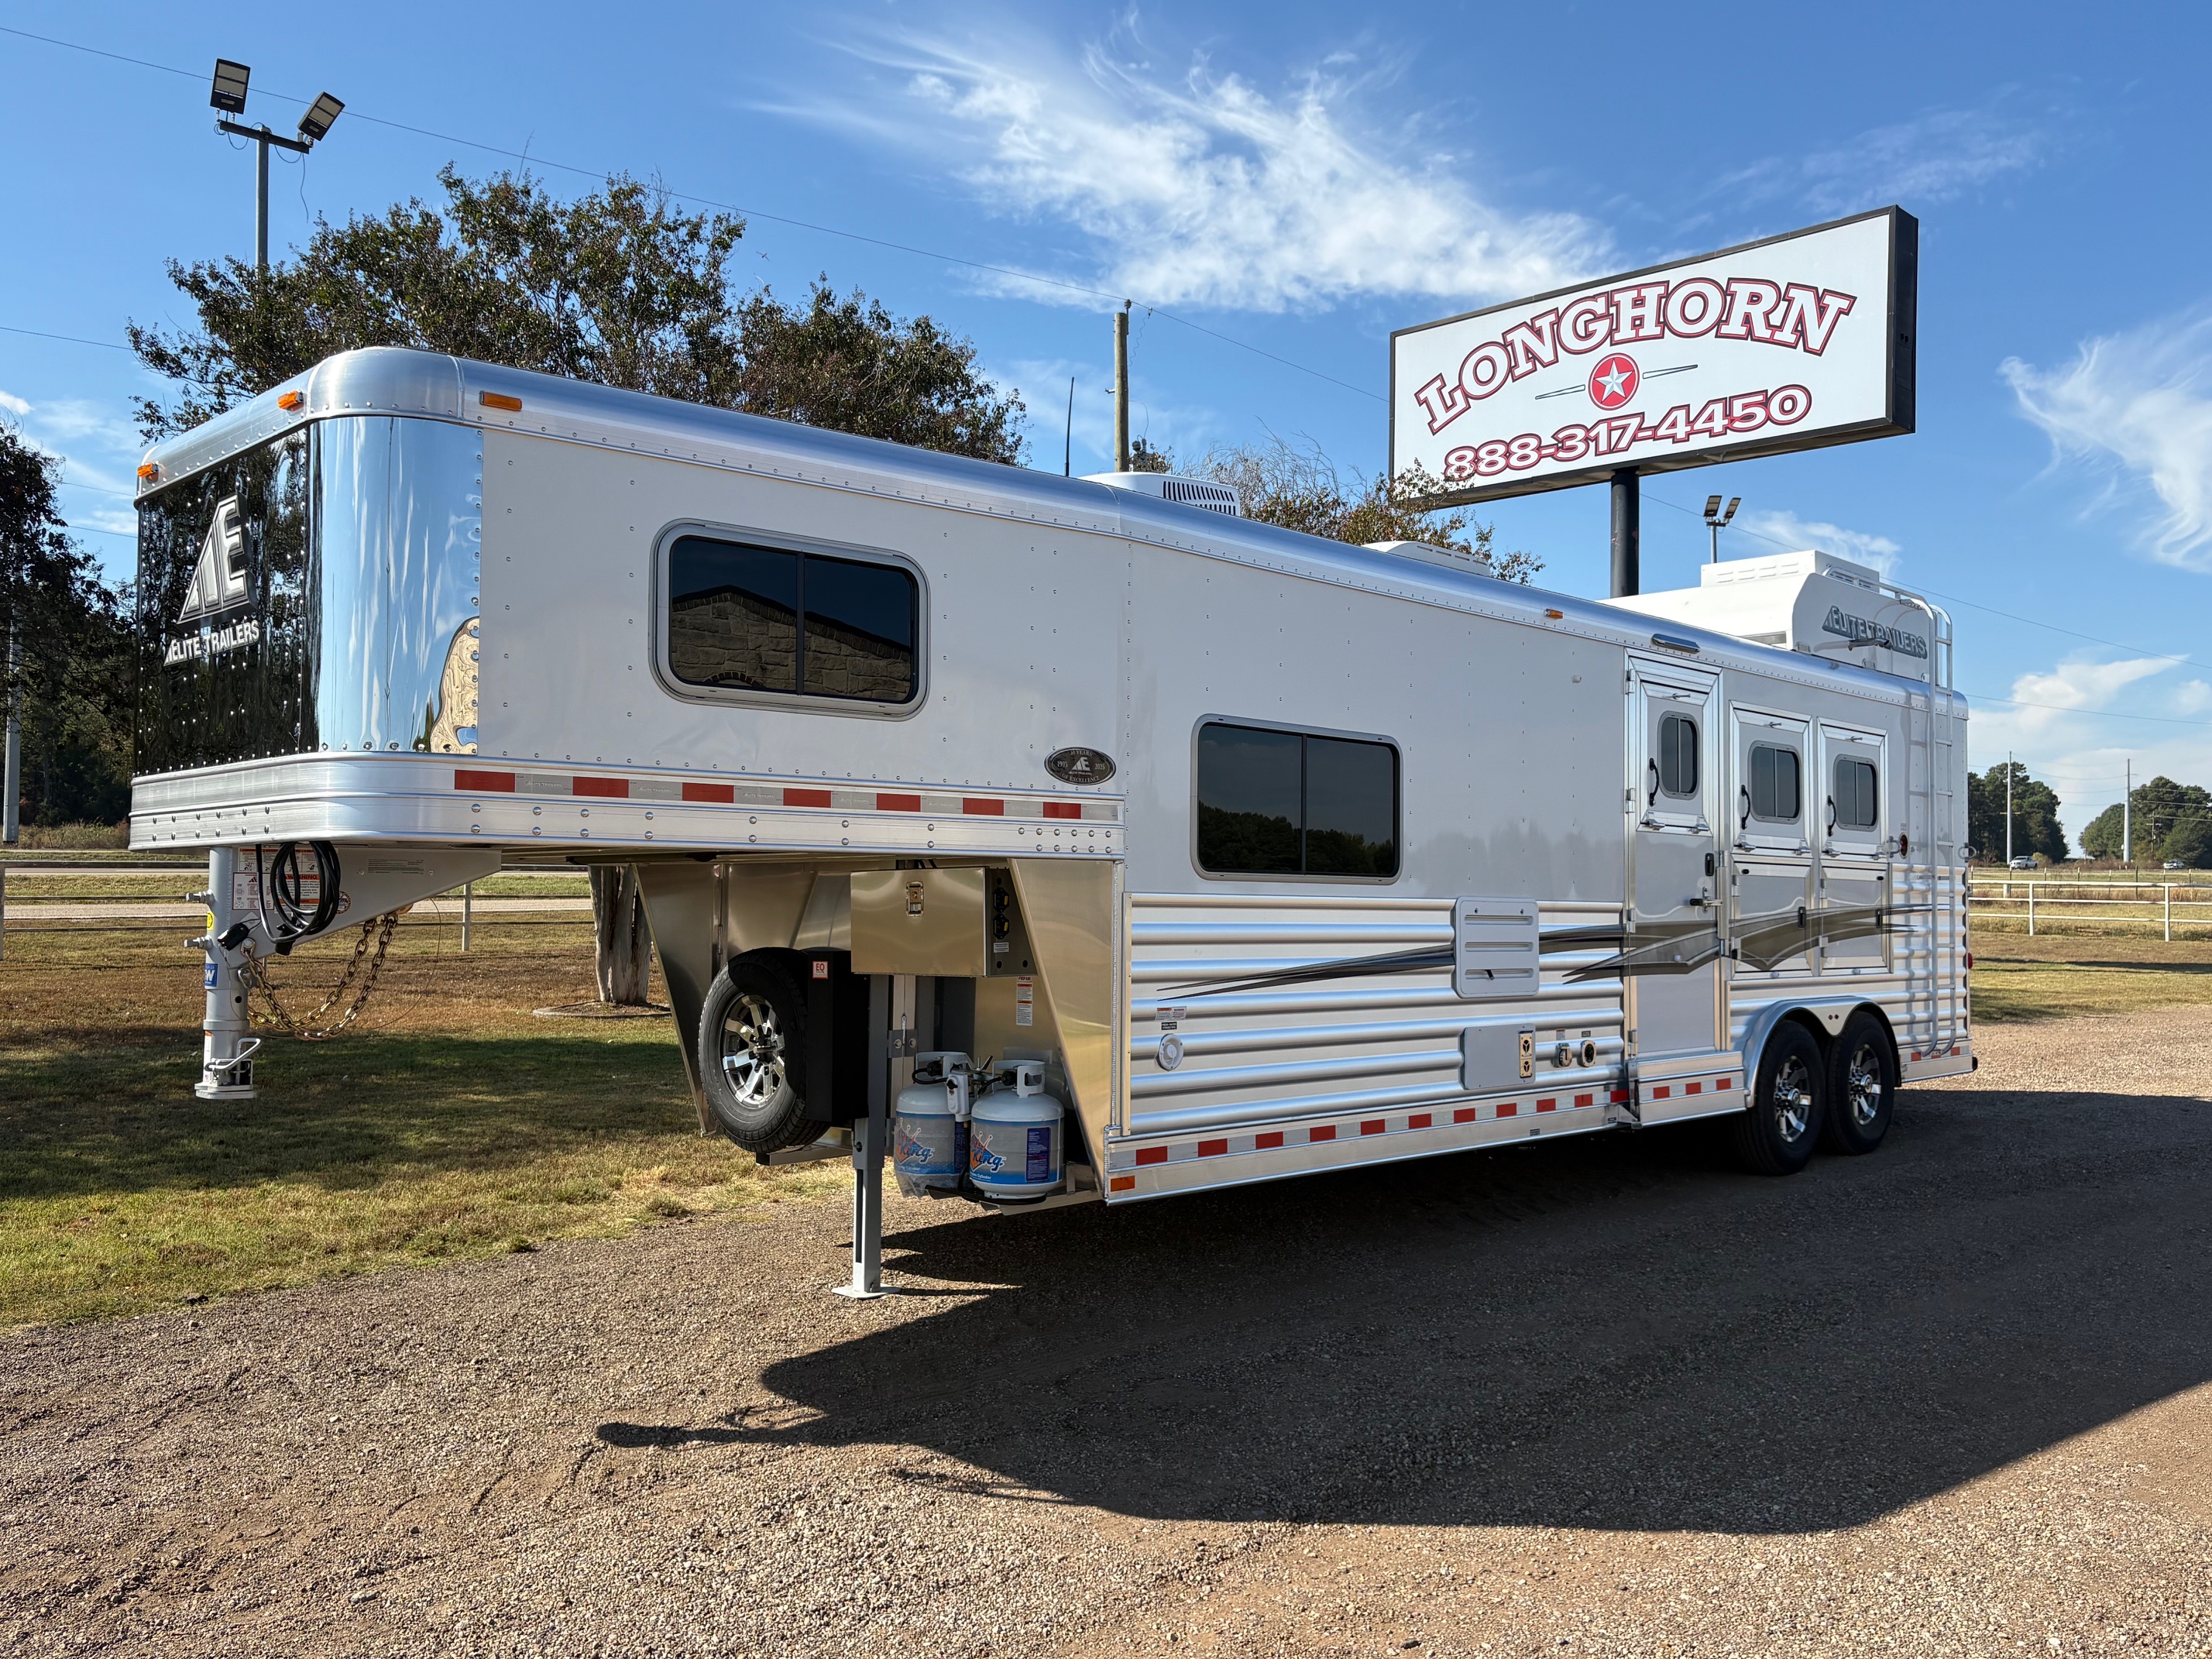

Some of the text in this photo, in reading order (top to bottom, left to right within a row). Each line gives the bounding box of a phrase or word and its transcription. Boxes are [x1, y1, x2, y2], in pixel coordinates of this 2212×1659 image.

[1414, 276, 1857, 435] LONGHORN
[1444, 384, 1812, 483] 888-317-4450
[202, 620, 260, 657] TRAILERS
[1866, 620, 1928, 660] TRAILERS
[816, 963, 826, 974] EQ
